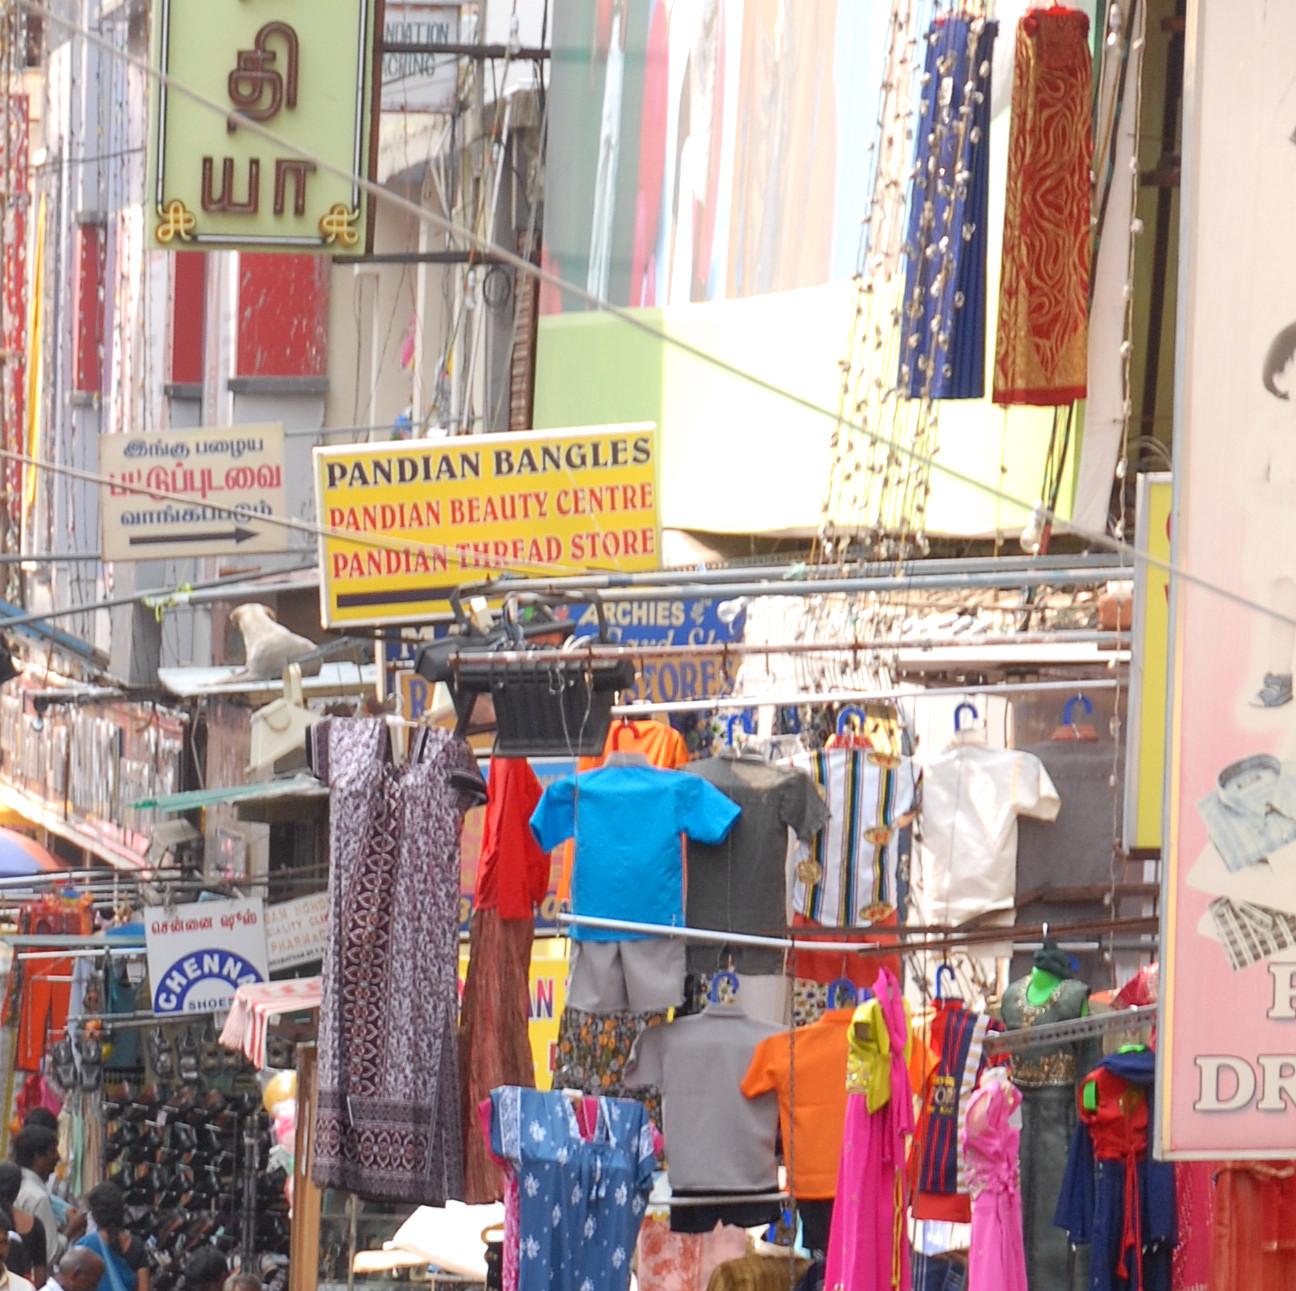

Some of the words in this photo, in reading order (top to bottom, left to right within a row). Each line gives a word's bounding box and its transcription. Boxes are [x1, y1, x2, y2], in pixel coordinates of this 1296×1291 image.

[326, 450, 481, 489] PANDIAN
[493, 437, 652, 477] BANGLES
[329, 499, 442, 533] PANDIAN
[449, 491, 549, 527] BEAUTY
[555, 481, 654, 516] CENTRE
[332, 543, 449, 579] PANDIAN
[455, 536, 563, 569] THREAD
[569, 528, 655, 561] STORE
[578, 601, 686, 627] ARCHIES
[158, 952, 258, 1010] CHENN
